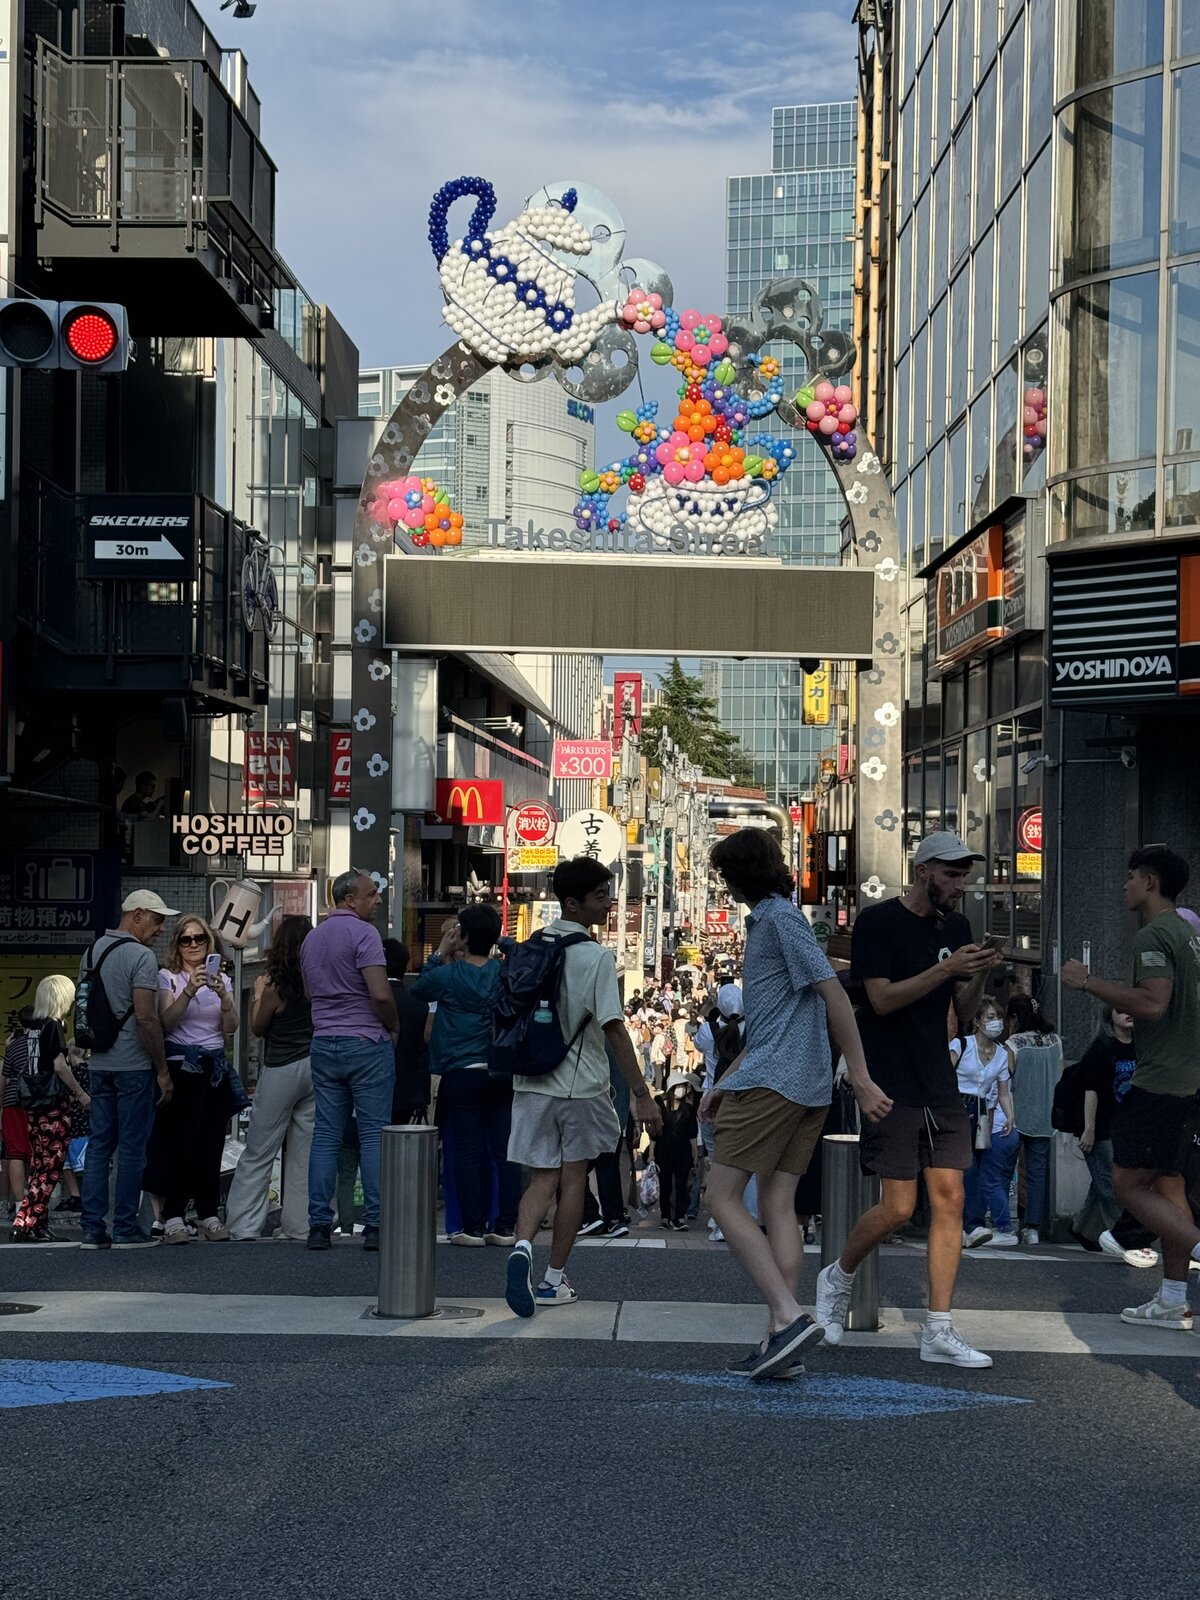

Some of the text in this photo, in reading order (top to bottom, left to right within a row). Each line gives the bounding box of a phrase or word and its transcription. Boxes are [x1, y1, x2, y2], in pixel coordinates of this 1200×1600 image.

[89, 515, 190, 527] SKECHERS
[484, 518, 775, 557] Takeshita Street
[115, 544, 149, 556] 30m
[1055, 655, 1172, 682] YOSHINOYA
[808, 664, 828, 711] ッカー
[561, 745, 607, 755] PARIS KID'S
[560, 756, 606, 776] ¥300
[172, 814, 293, 835] HOSHINO
[518, 816, 548, 831] 消火栓
[182, 834, 284, 855] COFFEE
[580, 812, 604, 861] 古着
[218, 902, 251, 938] H
